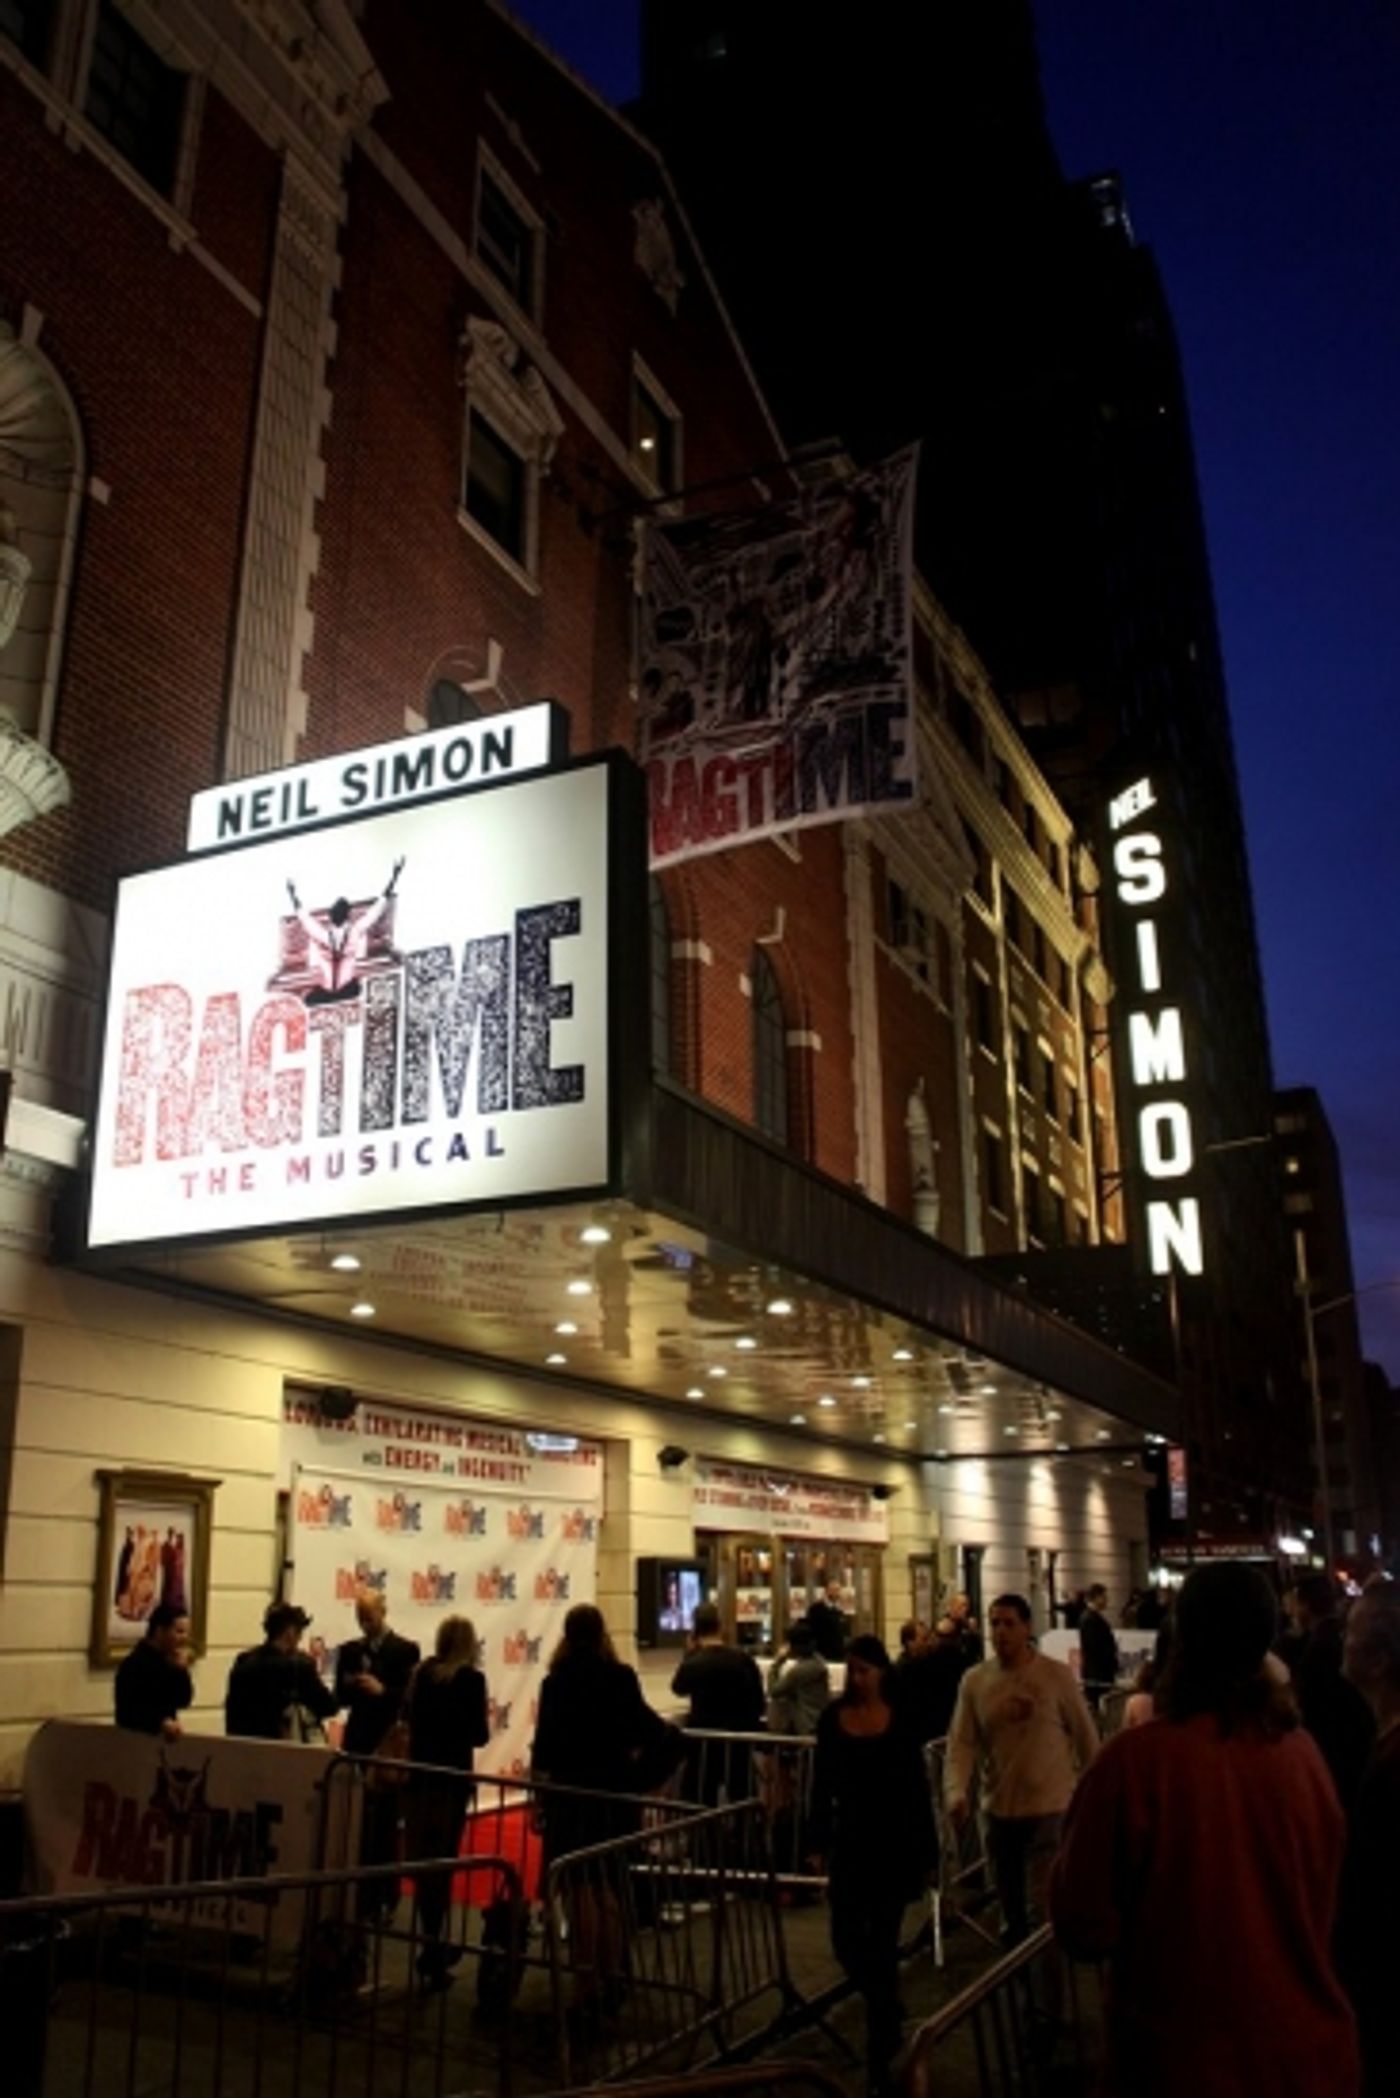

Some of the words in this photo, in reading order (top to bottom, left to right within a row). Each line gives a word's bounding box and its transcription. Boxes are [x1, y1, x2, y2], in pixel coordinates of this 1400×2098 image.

[217, 778, 318, 840] NEIL
[341, 725, 514, 808] SIMON
[1110, 778, 1157, 829] NEIL
[112, 897, 585, 1169] RAGTIME
[1113, 833, 1204, 1275] SIMON
[181, 1164, 255, 1199] THE
[287, 1127, 506, 1183] MUSICAL
